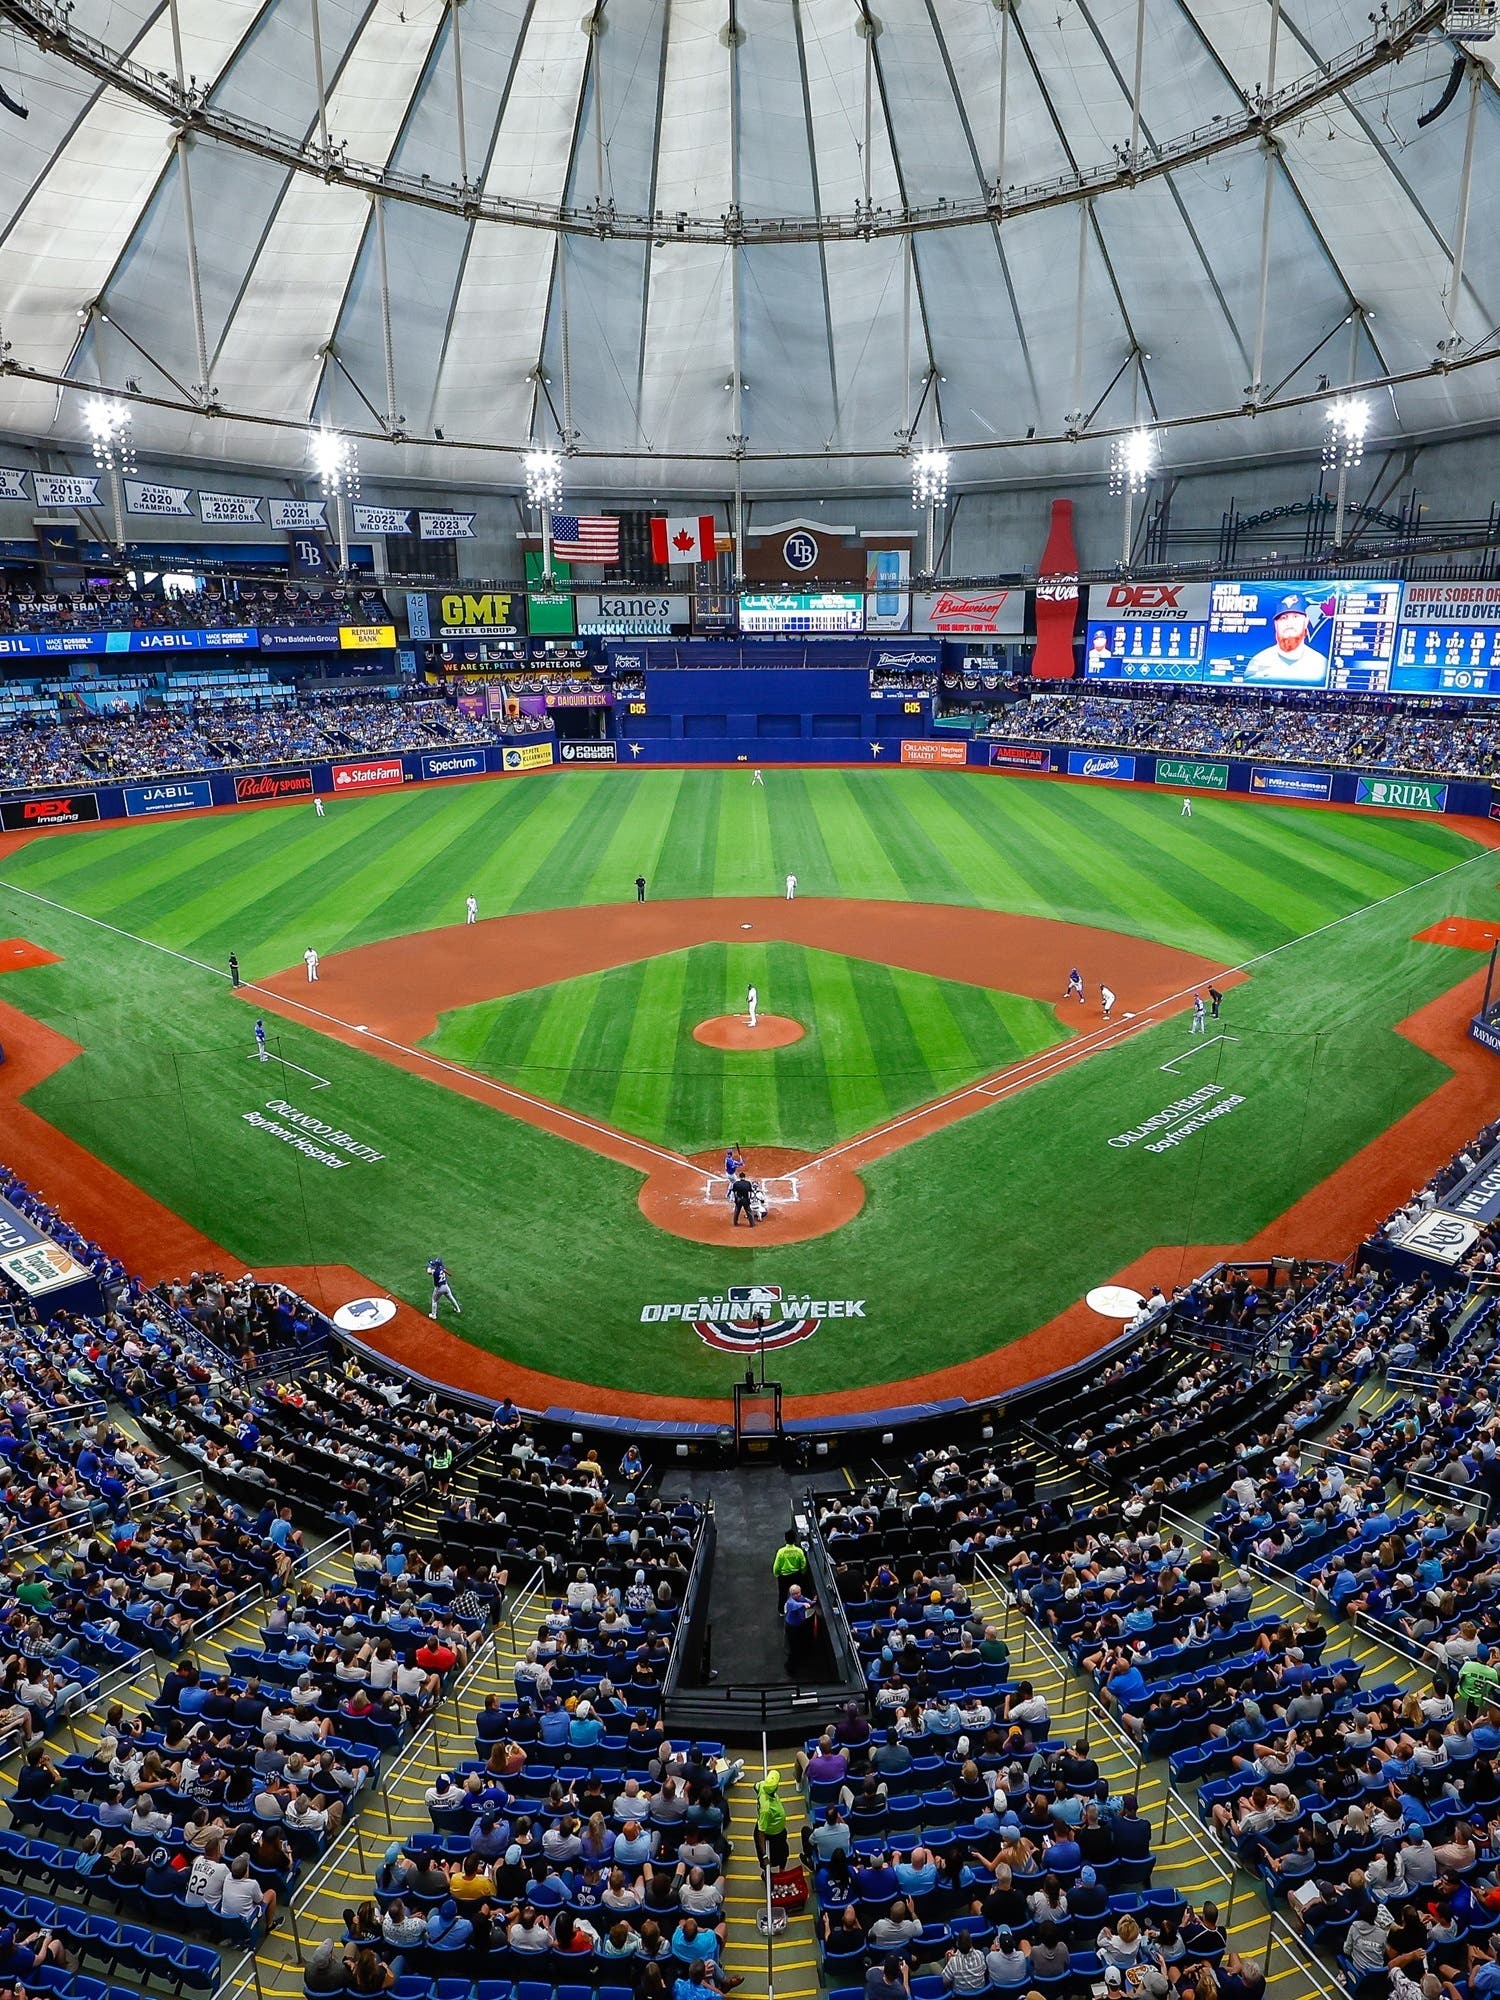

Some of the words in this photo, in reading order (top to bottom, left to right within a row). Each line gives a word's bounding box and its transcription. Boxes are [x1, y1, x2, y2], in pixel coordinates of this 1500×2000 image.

[51, 484, 82, 495] 2019
[43, 494, 65, 503] WILD
[69, 496, 92, 504] CARD
[141, 493, 172, 505] 2020
[134, 503, 182, 513] CHAMPIONS
[214, 503, 245, 513] 2020
[283, 508, 309, 518] 2021
[206, 512, 255, 521] CHAMPIONS
[367, 514, 395, 525] 2022
[382, 524, 404, 532] CARD
[432, 520, 459, 530] 2023
[296, 541, 321, 566] TB
[790, 539, 813, 563] TB
[1107, 585, 1185, 608] DEX
[1409, 588, 1443, 602] DRIVE
[1445, 587, 1483, 602] SOBER
[411, 596, 424, 607] 42
[937, 599, 1000, 615] Budweiser
[1212, 595, 1258, 612] TURNER
[441, 594, 512, 626] GMF
[1123, 607, 1188, 619] imaging
[1404, 604, 1426, 618] GET
[1427, 604, 1471, 618] PULLED
[413, 611, 424, 622] 12
[352, 628, 382, 636] REPUBLIC
[413, 626, 427, 636] 66
[140, 634, 193, 647] JABIL
[289, 635, 316, 643] Baldwin
[316, 635, 338, 643] Group
[530, 661, 581, 669] STPETE.ORG
[615, 660, 640, 668] PORCH
[911, 655, 936, 663] PORCH
[557, 695, 587, 706] DAIQUIRI
[589, 695, 606, 705] DECK
[630, 703, 646, 714] 0:05
[904, 702, 920, 713] 0:05
[904, 744, 938, 752] ORLANDO
[997, 748, 1043, 760] AMERICAN
[429, 757, 475, 774] Spectrum
[1083, 757, 1119, 776] Culver's
[1159, 763, 1190, 783] Quality
[1193, 765, 1223, 785] Roofing
[237, 775, 279, 798] Bally
[279, 777, 311, 791] SPORTS
[1268, 778, 1328, 790] MicroLumen
[143, 786, 194, 800] JABIL
[1387, 784, 1432, 808] RIPA
[24, 800, 73, 818] DEX
[1107, 1105, 1180, 1148] ORLANDO
[1172, 1083, 1225, 1112] HEALTH
[1144, 1120, 1204, 1153] Bayfront
[1194, 1093, 1247, 1127] Hospital
[265, 1099, 332, 1135] ORLANDO
[324, 1130, 387, 1163] HEALTH
[241, 1111, 298, 1142] Bayfront
[289, 1137, 351, 1169] Hospital
[1409, 1219, 1465, 1253] RAYS
[23, 1249, 60, 1280] Tropicana
[640, 1302, 772, 1323] OPENING
[779, 1300, 867, 1319] WEEK
[194, 1862, 216, 1877] ARCHER
[189, 1874, 207, 1897] 22
